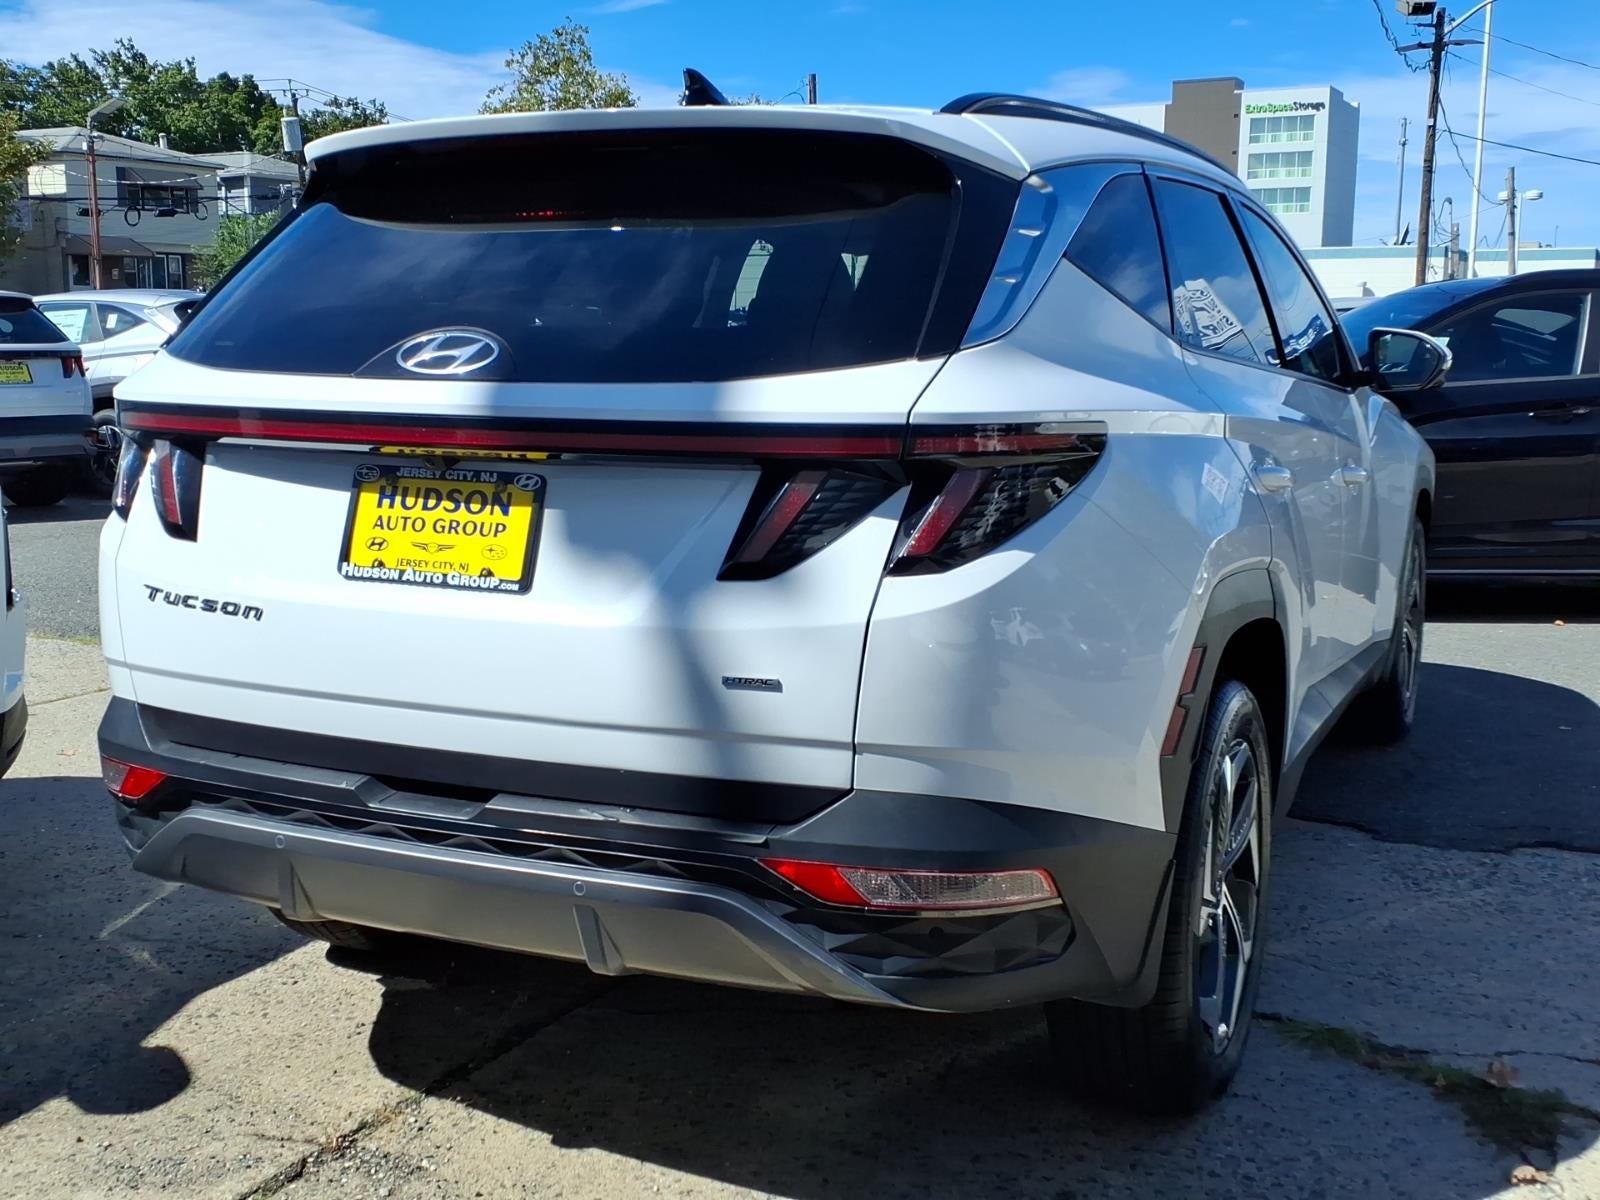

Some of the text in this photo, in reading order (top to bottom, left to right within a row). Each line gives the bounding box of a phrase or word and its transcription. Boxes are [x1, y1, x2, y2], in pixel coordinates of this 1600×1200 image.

[396, 467, 498, 482] JERSEY CITY, NJ
[377, 485, 512, 516] HUDSON
[372, 515, 507, 538] AUTO GROUP
[341, 562, 400, 580] HUDSON
[401, 567, 444, 584] AUTO
[396, 558, 470, 572] JERSEY CITY, NJ
[143, 584, 264, 621] TUCSON
[725, 676, 777, 687] HTRAC
